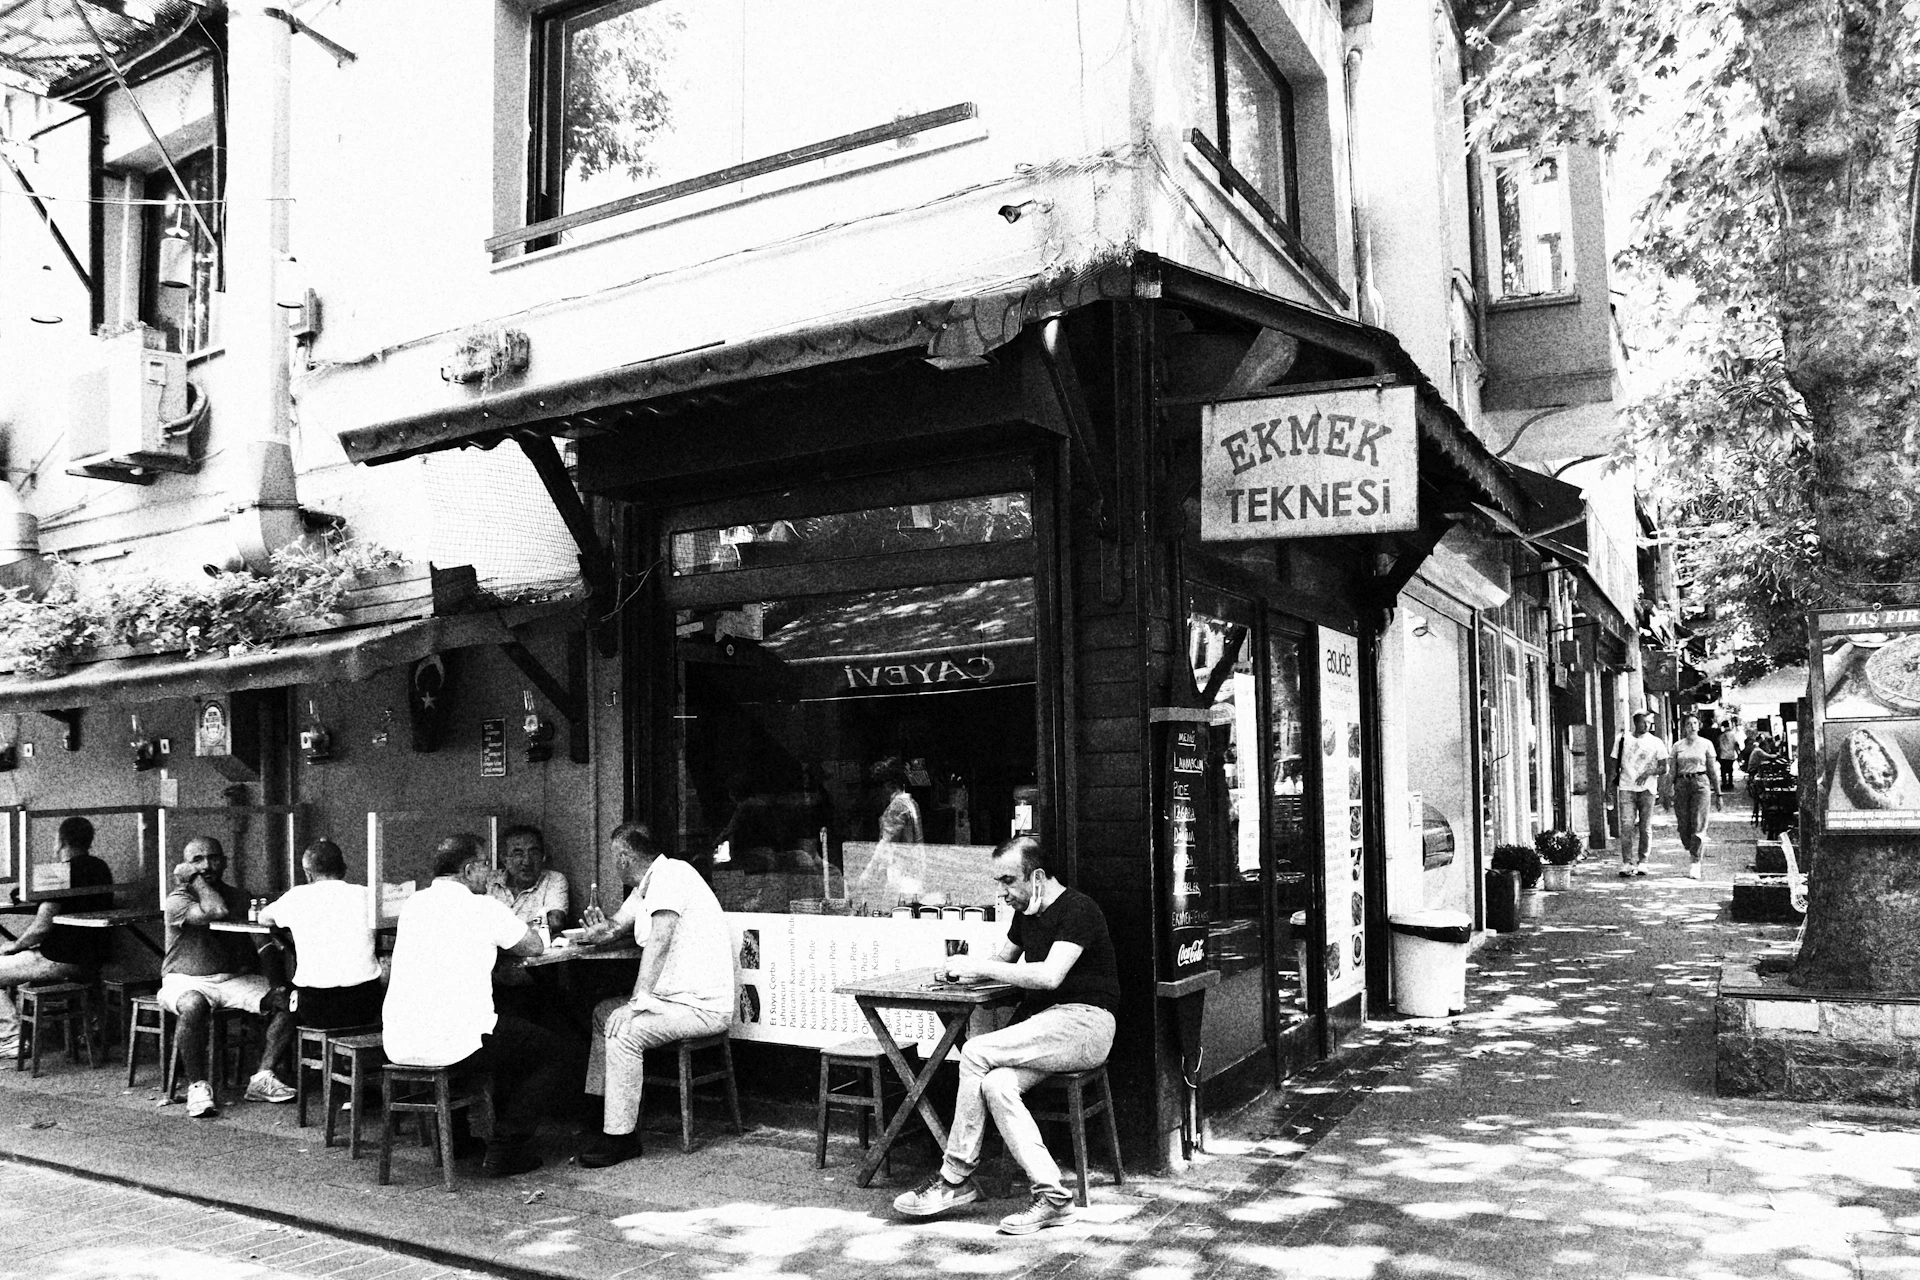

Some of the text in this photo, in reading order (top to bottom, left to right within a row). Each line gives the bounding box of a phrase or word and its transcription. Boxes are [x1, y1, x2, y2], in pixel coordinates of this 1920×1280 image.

[1220, 413, 1392, 476] EKMEK
[1846, 612, 1879, 628] TAŞ
[1327, 643, 1352, 677] asude
[788, 915, 796, 935] Pide
[808, 940, 816, 960] Pide
[849, 941, 857, 961] Pide
[872, 941, 880, 970] Kebap
[769, 962, 778, 1026] Et Suyu Çorba
[779, 981, 787, 1027] Lahmacun
[893, 1010, 901, 1038] Tavuk
[916, 1013, 924, 1040] Sucuk
